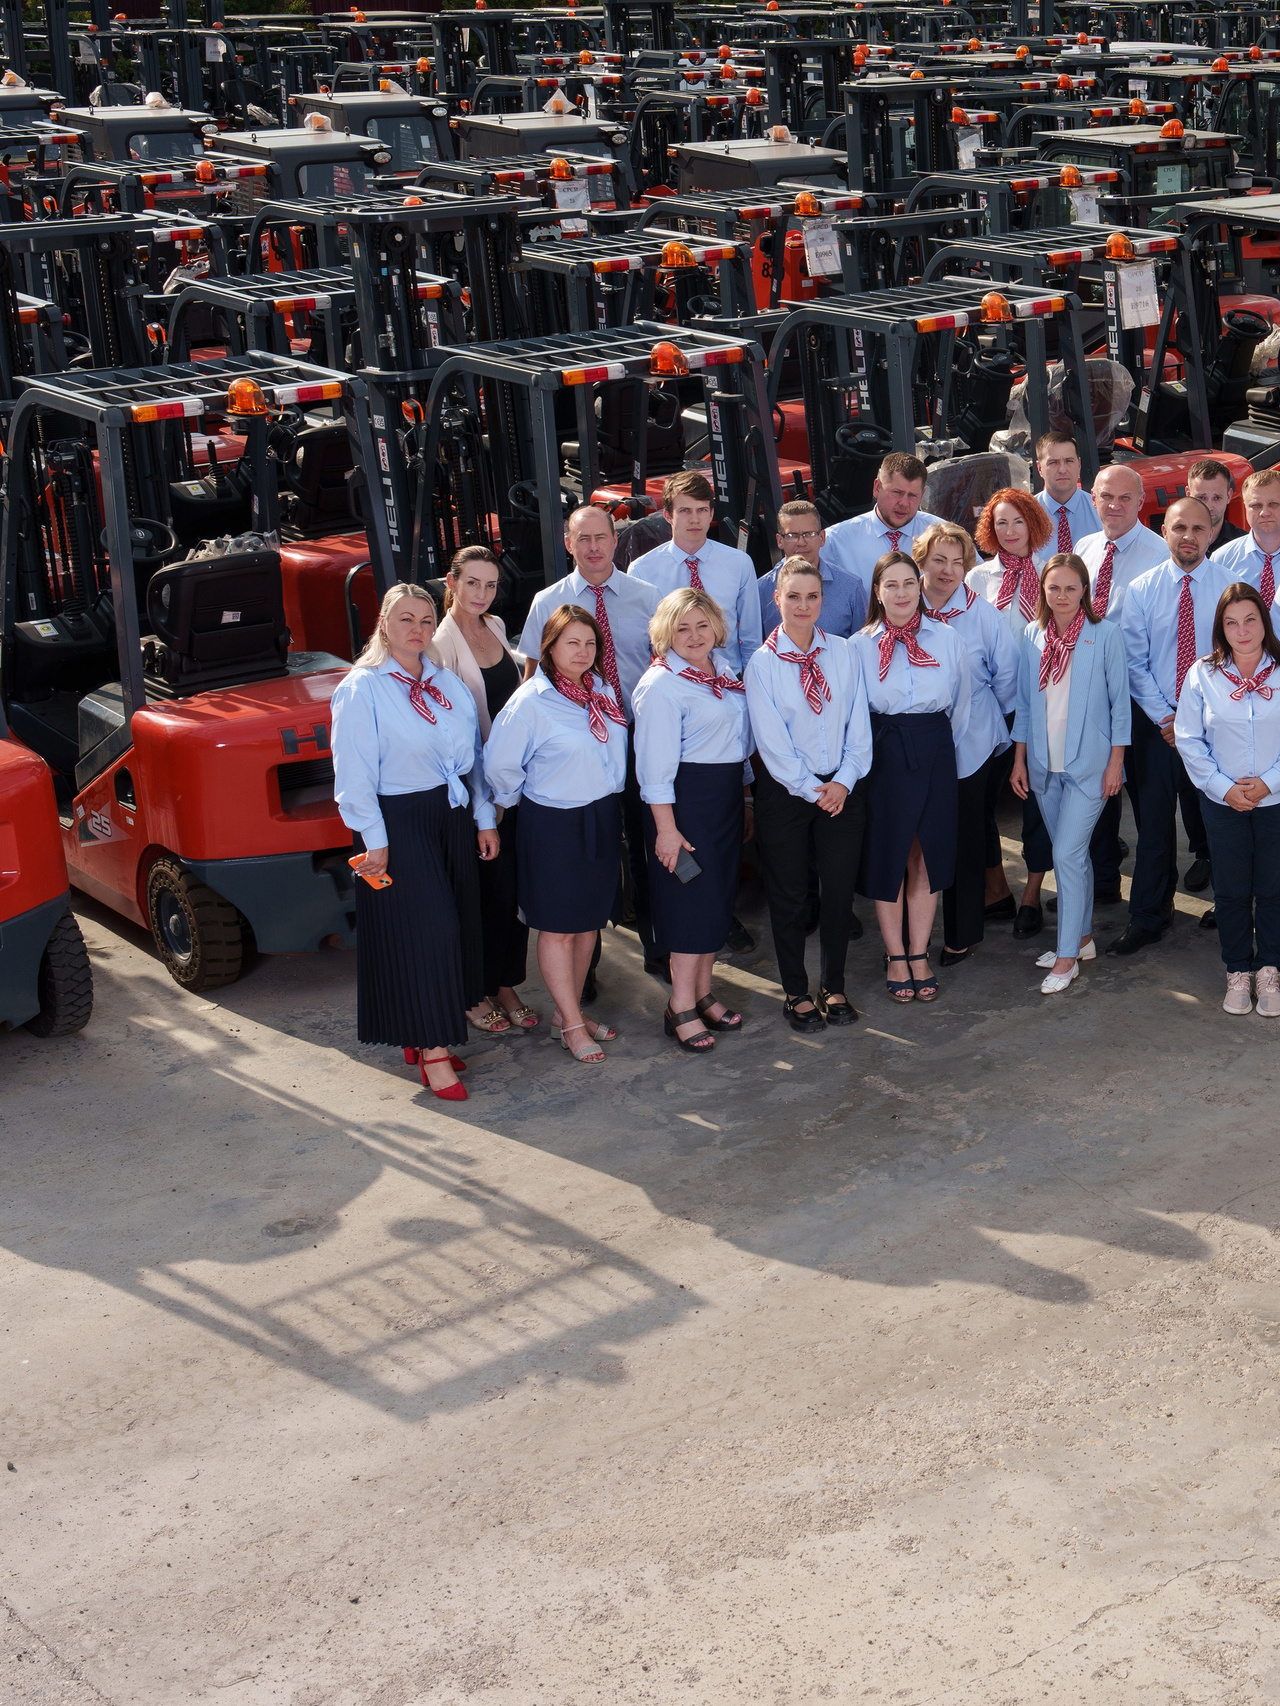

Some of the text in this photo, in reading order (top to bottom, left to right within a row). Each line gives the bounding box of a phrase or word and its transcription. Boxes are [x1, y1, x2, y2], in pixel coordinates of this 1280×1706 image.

[1107, 309, 1120, 364] HELI
[855, 350, 871, 411] HELI
[712, 433, 730, 503] HELI
[382, 477, 401, 553] HELI
[90, 809, 113, 838] 25
